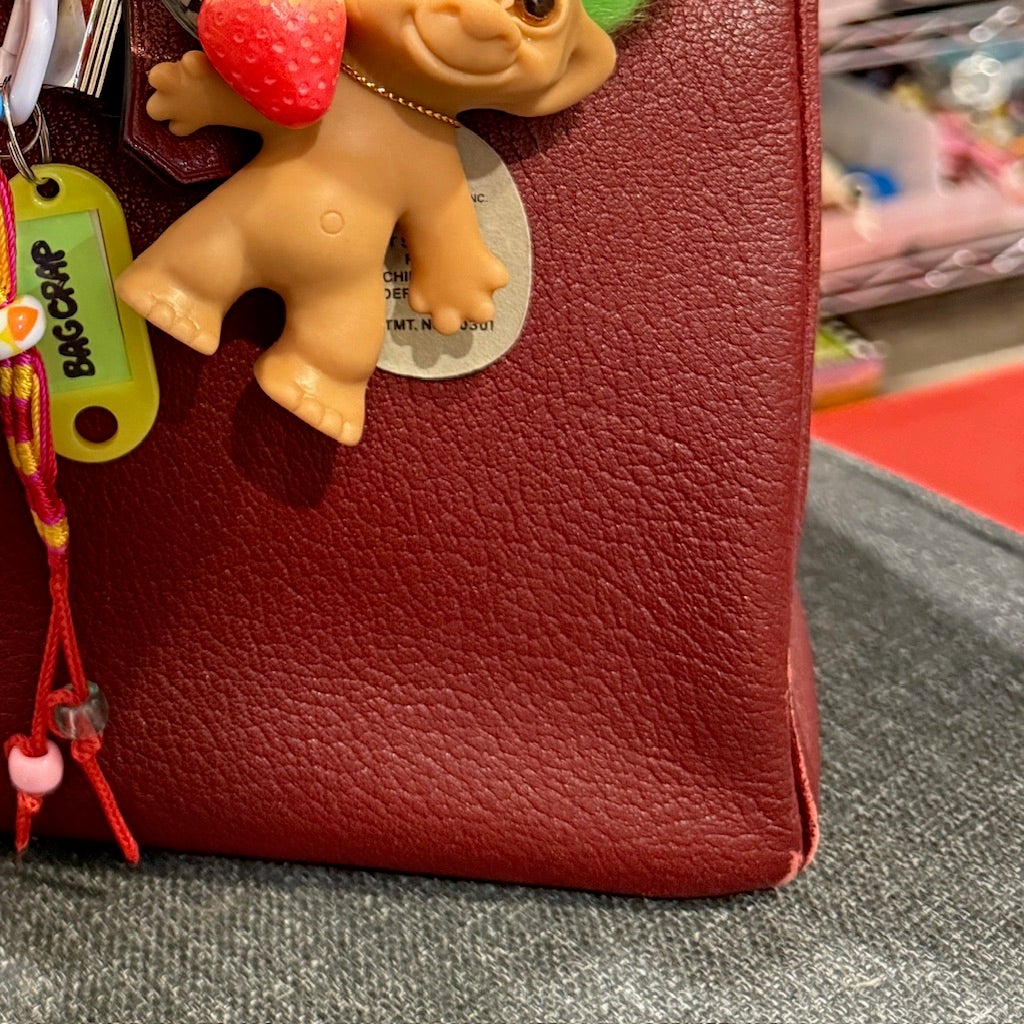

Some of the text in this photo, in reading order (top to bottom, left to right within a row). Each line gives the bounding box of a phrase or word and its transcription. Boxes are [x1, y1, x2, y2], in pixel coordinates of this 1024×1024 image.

[383, 271, 412, 283] CHI
[31, 240, 96, 378] BAG CRAP
[386, 319, 418, 331] TMT.
